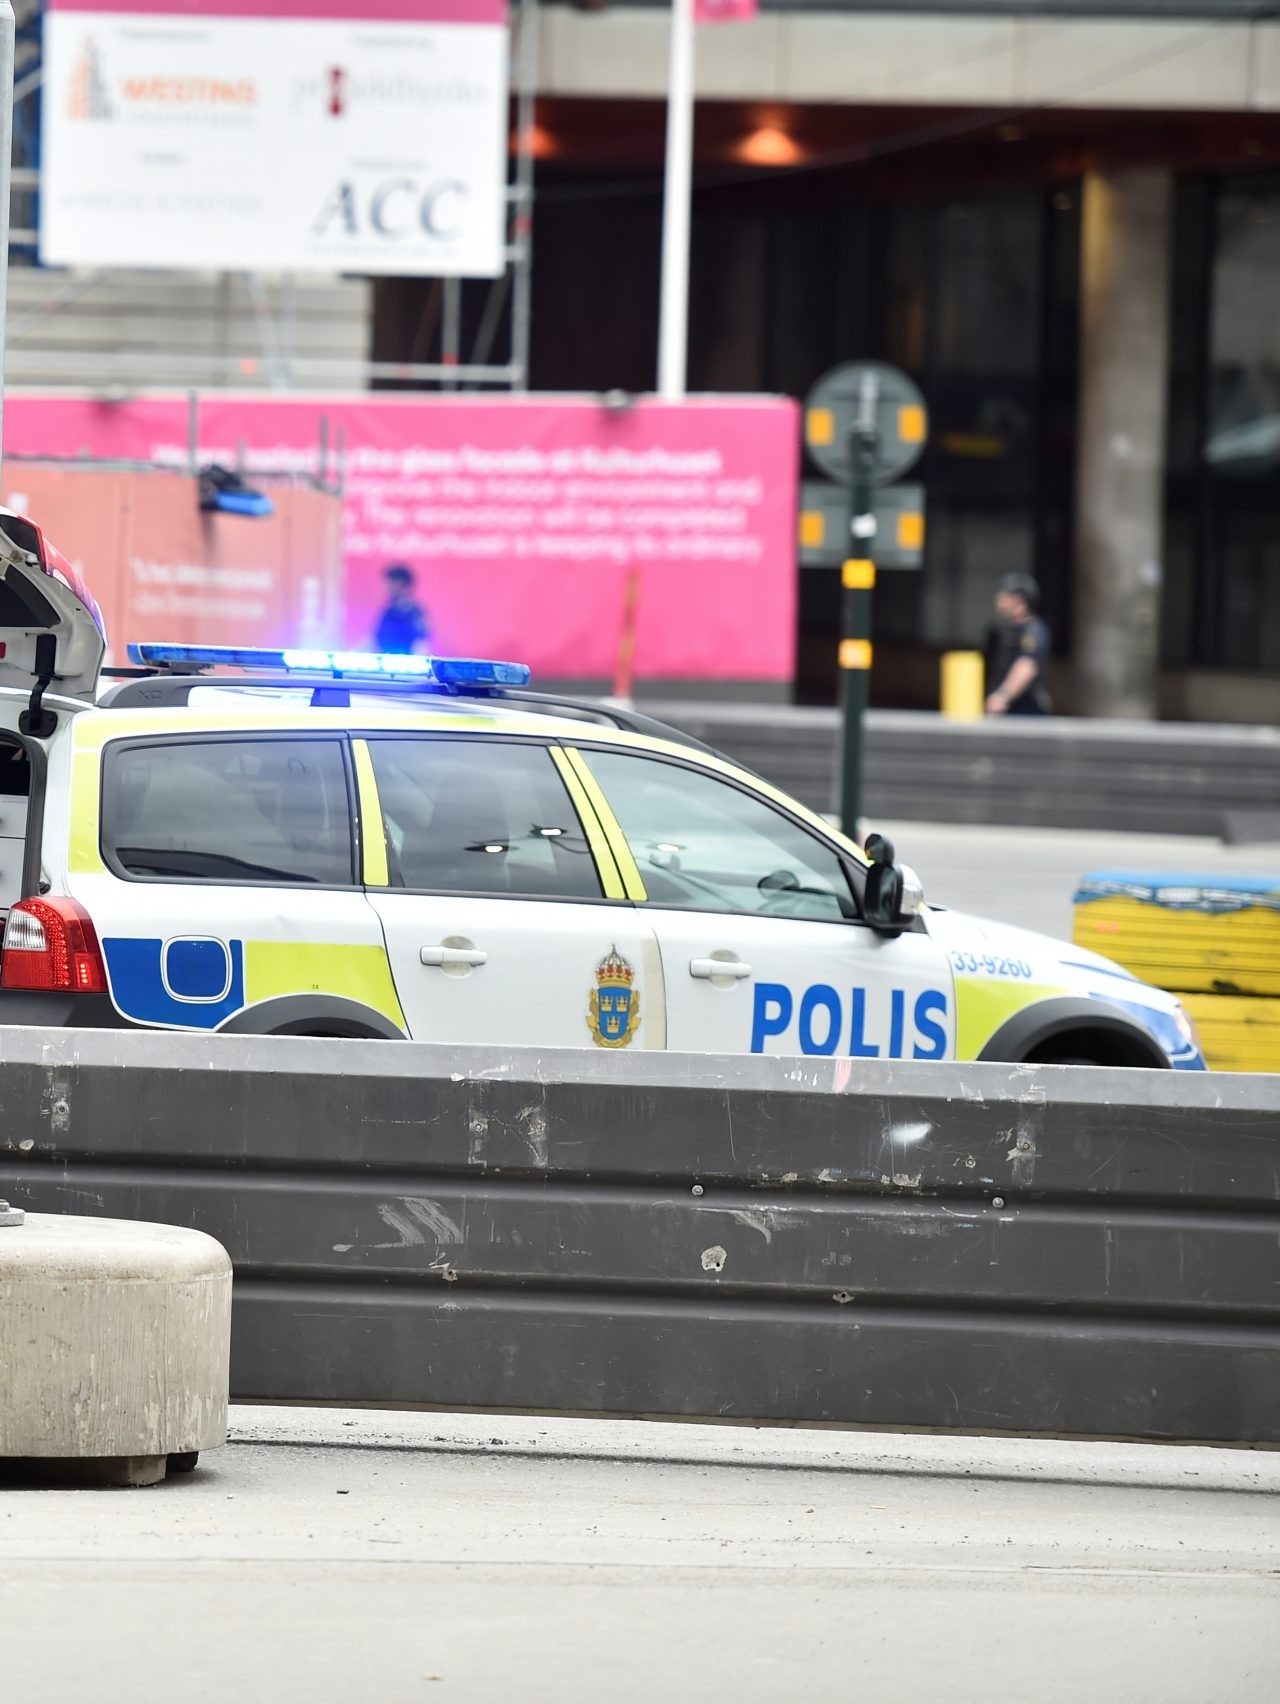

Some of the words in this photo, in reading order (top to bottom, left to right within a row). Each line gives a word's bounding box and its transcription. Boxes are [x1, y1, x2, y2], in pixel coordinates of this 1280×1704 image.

[310, 178, 470, 240] ACC
[951, 950, 1032, 978] 33-9260
[750, 982, 948, 1061] POLIS
